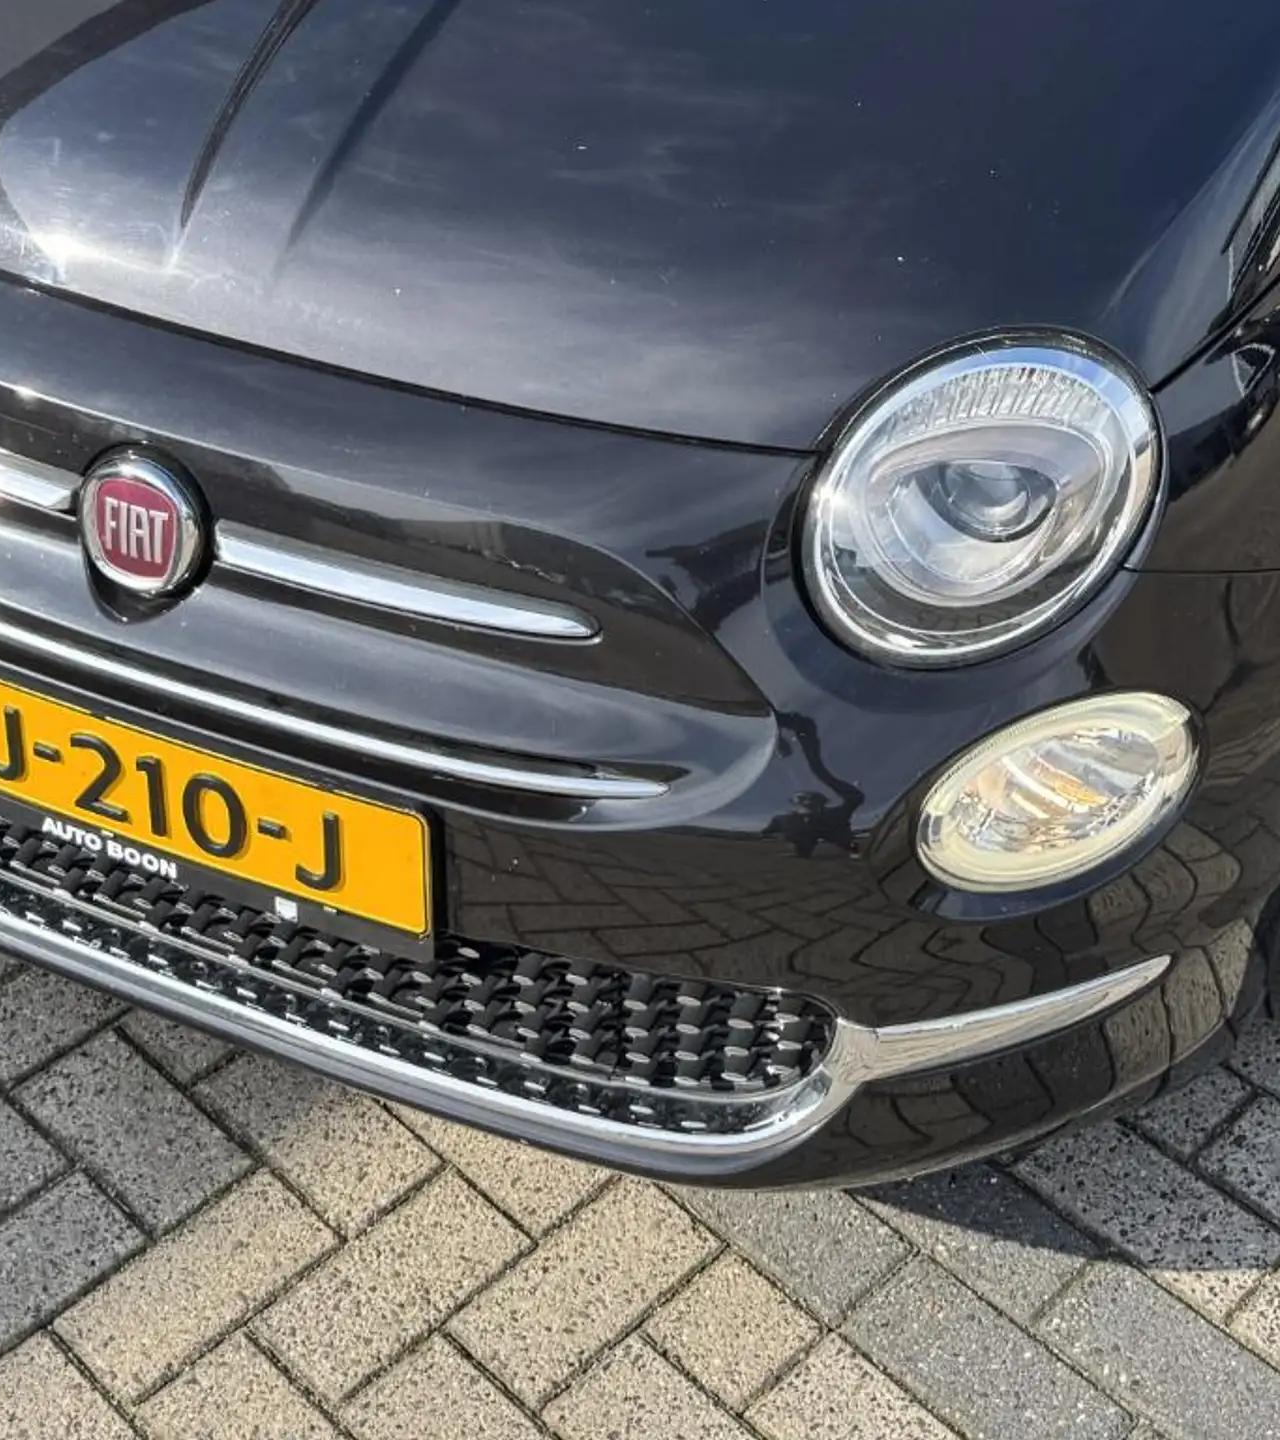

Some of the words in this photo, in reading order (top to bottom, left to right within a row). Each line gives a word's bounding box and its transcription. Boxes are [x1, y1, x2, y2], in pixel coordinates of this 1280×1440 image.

[103, 496, 169, 564] FIAT
[41, 817, 102, 853] AUTO
[107, 840, 177, 879] BOON
